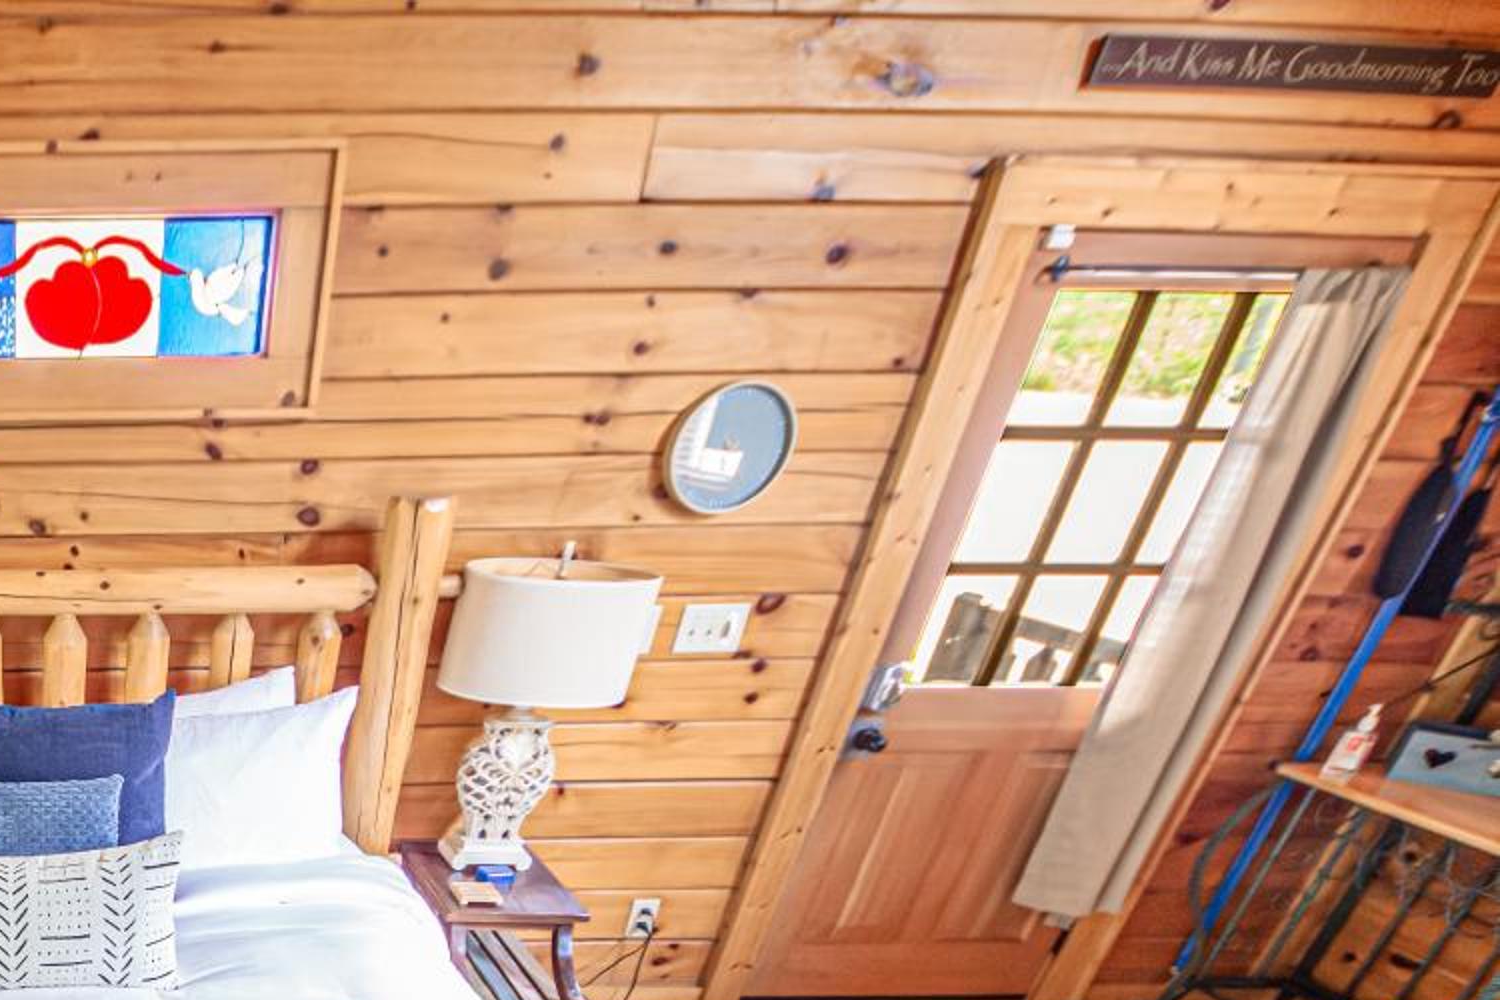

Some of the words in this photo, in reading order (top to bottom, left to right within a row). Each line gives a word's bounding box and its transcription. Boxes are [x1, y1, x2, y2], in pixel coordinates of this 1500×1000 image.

[1178, 42, 1236, 80] Kiss
[1236, 43, 1282, 80] Me
[1454, 53, 1500, 90] Too
